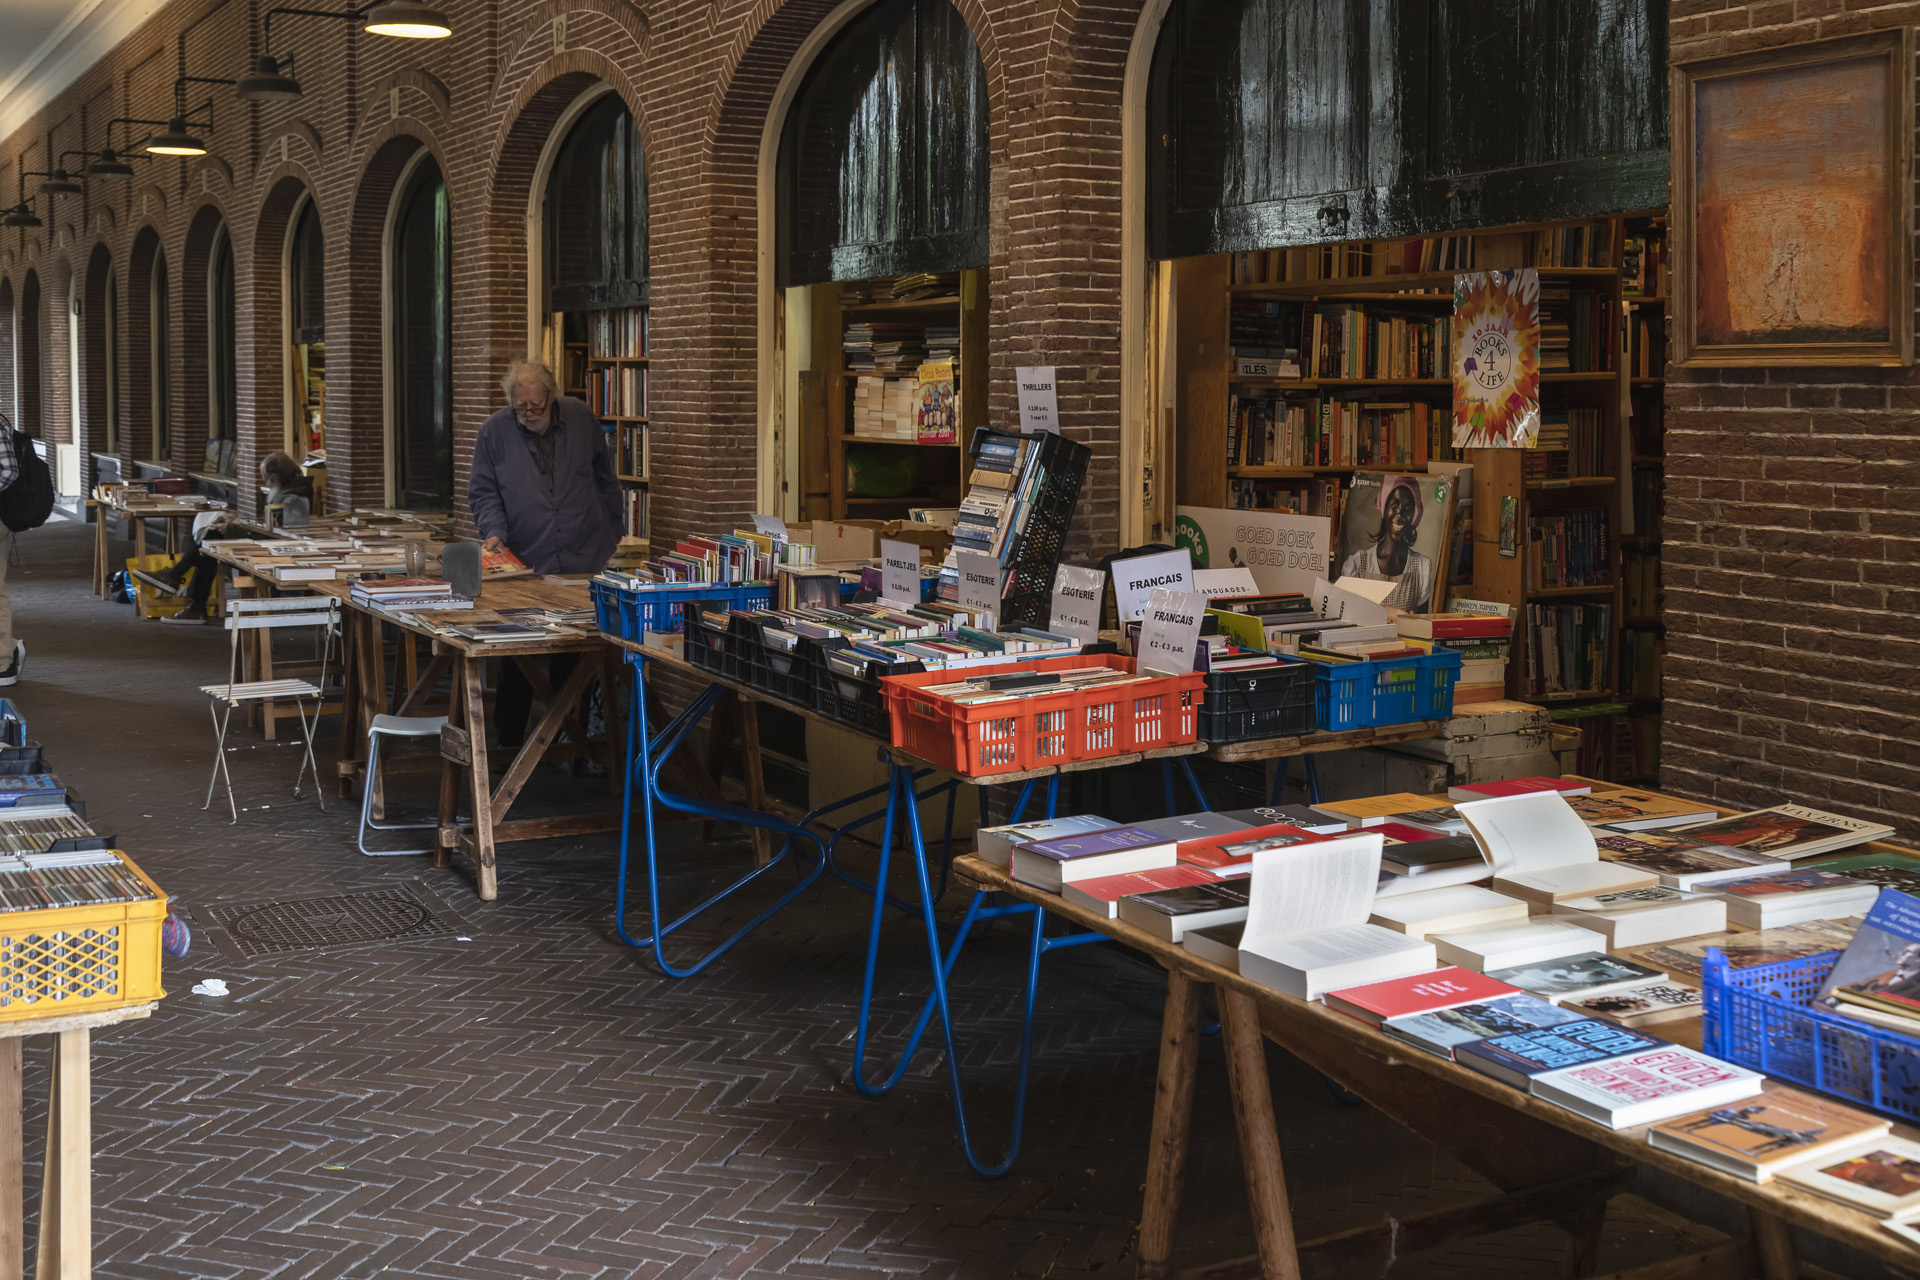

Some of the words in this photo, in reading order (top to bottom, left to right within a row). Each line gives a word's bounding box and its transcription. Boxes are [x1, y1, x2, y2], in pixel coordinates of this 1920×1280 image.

[1472, 329, 1482, 342] 10
[1484, 324, 1509, 338] JAAR
[1475, 336, 1508, 358] BOOKS
[1484, 350, 1496, 371] 4
[1478, 371, 1504, 386] LIFE
[1025, 514, 1036, 538] CRIME
[1236, 525, 1275, 544] GOED
[1277, 528, 1315, 549] BOEK
[1016, 540, 1028, 562] CLUB
[1247, 547, 1285, 566] GOED
[1288, 551, 1325, 571] DOEL
[886, 558, 917, 572] PARELTJES
[966, 572, 995, 586] ESOTERIE
[1130, 572, 1183, 591] FRANCAIS
[1062, 587, 1095, 600] ESOTERIE
[1153, 611, 1194, 625] FRANCAIS
[1777, 807, 1818, 819] MAX
[1816, 815, 1874, 830] ERNST
